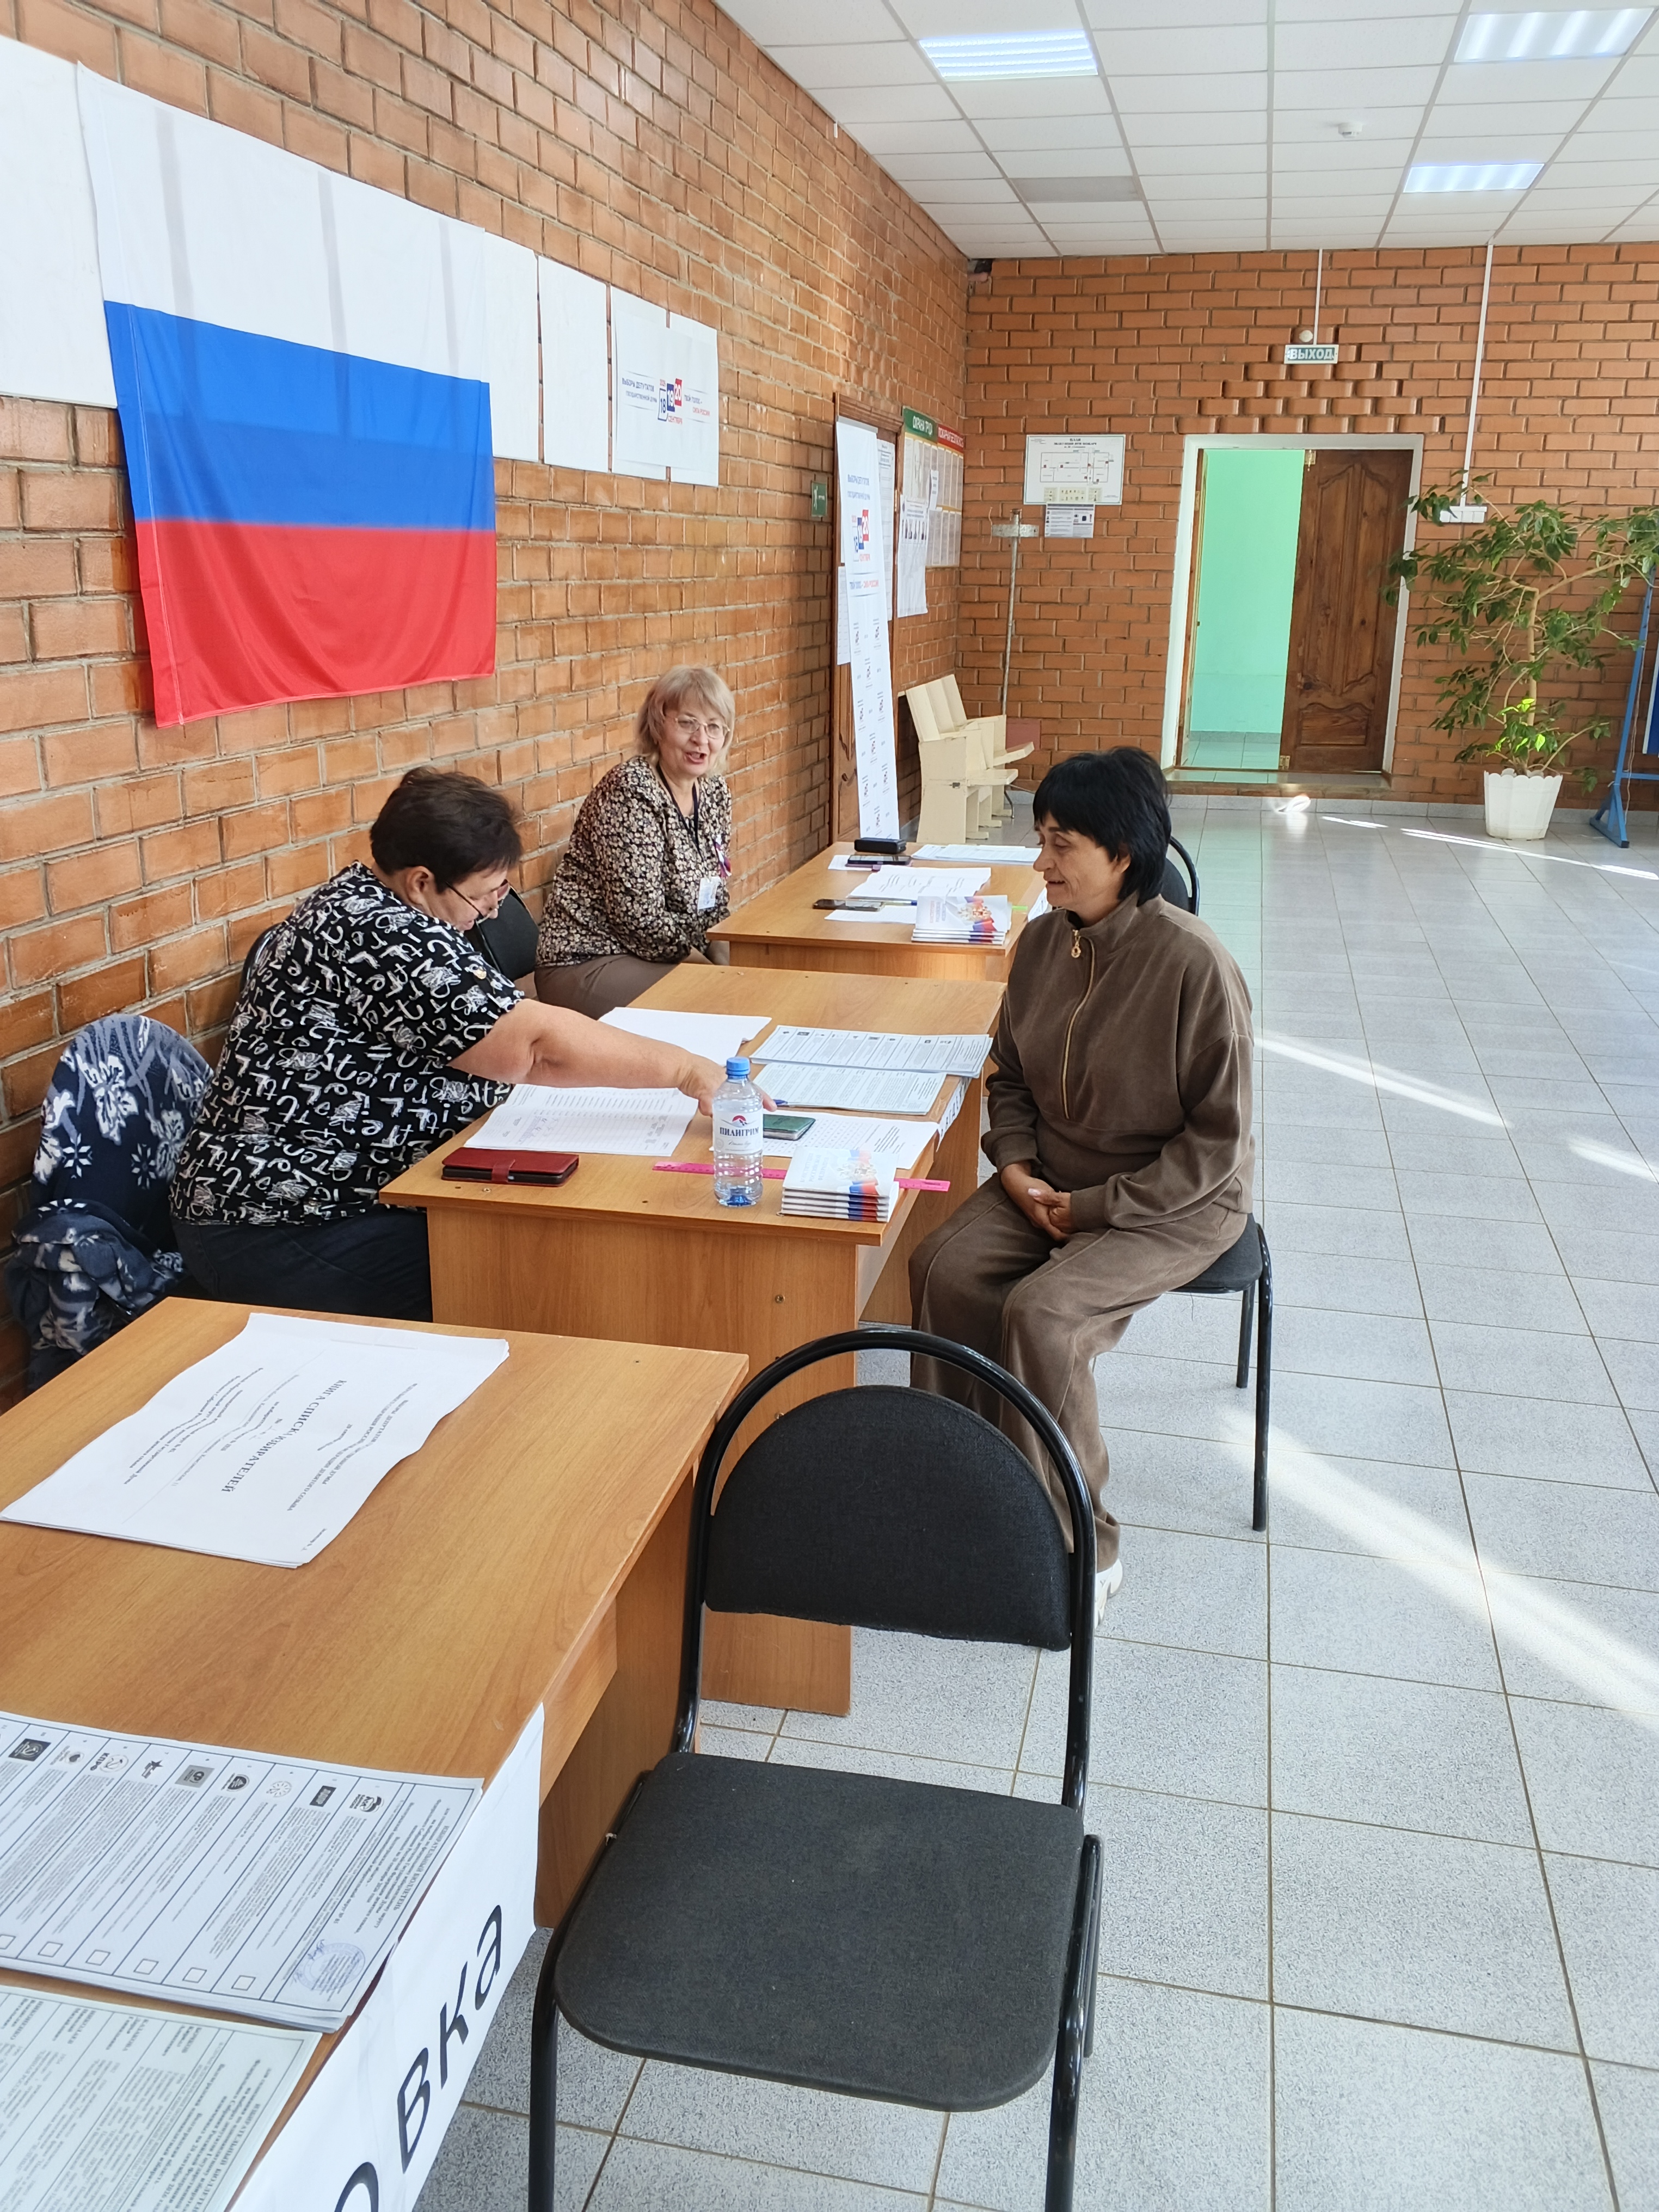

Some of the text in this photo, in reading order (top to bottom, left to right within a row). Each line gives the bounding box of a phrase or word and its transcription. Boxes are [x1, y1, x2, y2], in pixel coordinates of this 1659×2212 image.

[1290, 348, 1332, 360] ВЫХОД
[667, 390, 674, 407] 19
[675, 383, 681, 401] 20
[660, 398, 666, 413] 18
[913, 415, 925, 432] ОХРАНА
[862, 516, 869, 534] 20
[720, 1127, 759, 1136] ПИЛИГРИМ
[222, 1379, 348, 1493] КНИГА СПИСКА ИЗБИРАТЕЛЕЙ
[90, 1753, 110, 1771] КПРФ
[315, 1788, 331, 1805] ЛДПР
[349, 1794, 360, 1808] РОССИЯ
[391, 1802, 414, 1832] Волгоградский
[420, 1825, 433, 1841] выборах
[427, 1816, 446, 1840] голосования
[398, 1825, 418, 1851] назначенных
[371, 1832, 395, 1864] одномандатный
[405, 1842, 422, 1862] депутатов
[353, 1798, 441, 1934] Федерального Собрания Российской Федерации девятого созыва,
[392, 1825, 449, 1910] ИЗБИРАТЕЛЬНЫЙ БЮЛЛЕТЕНЬ
[405, 1846, 428, 1875] федеральному
[378, 1862, 395, 1881] сентября
[348, 1865, 374, 1898] избирательный
[372, 1882, 383, 1893] 2026
[383, 1863, 410, 1900] Государственной
[365, 1893, 374, 1902] года
[383, 1876, 409, 1912] избирательному
[339, 1898, 353, 1912] округ
[374, 1900, 387, 1913] Думы
[373, 1912, 387, 1928] округу
[9, 2000, 44, 2040] НИКОНЕНКО
[51, 2007, 81, 2042] Михайлович
[66, 2010, 96, 2044] НИКОЛАЕВ
[67, 2008, 89, 2033] Николай
[121, 2018, 149, 2051] КАЗАКОВА
